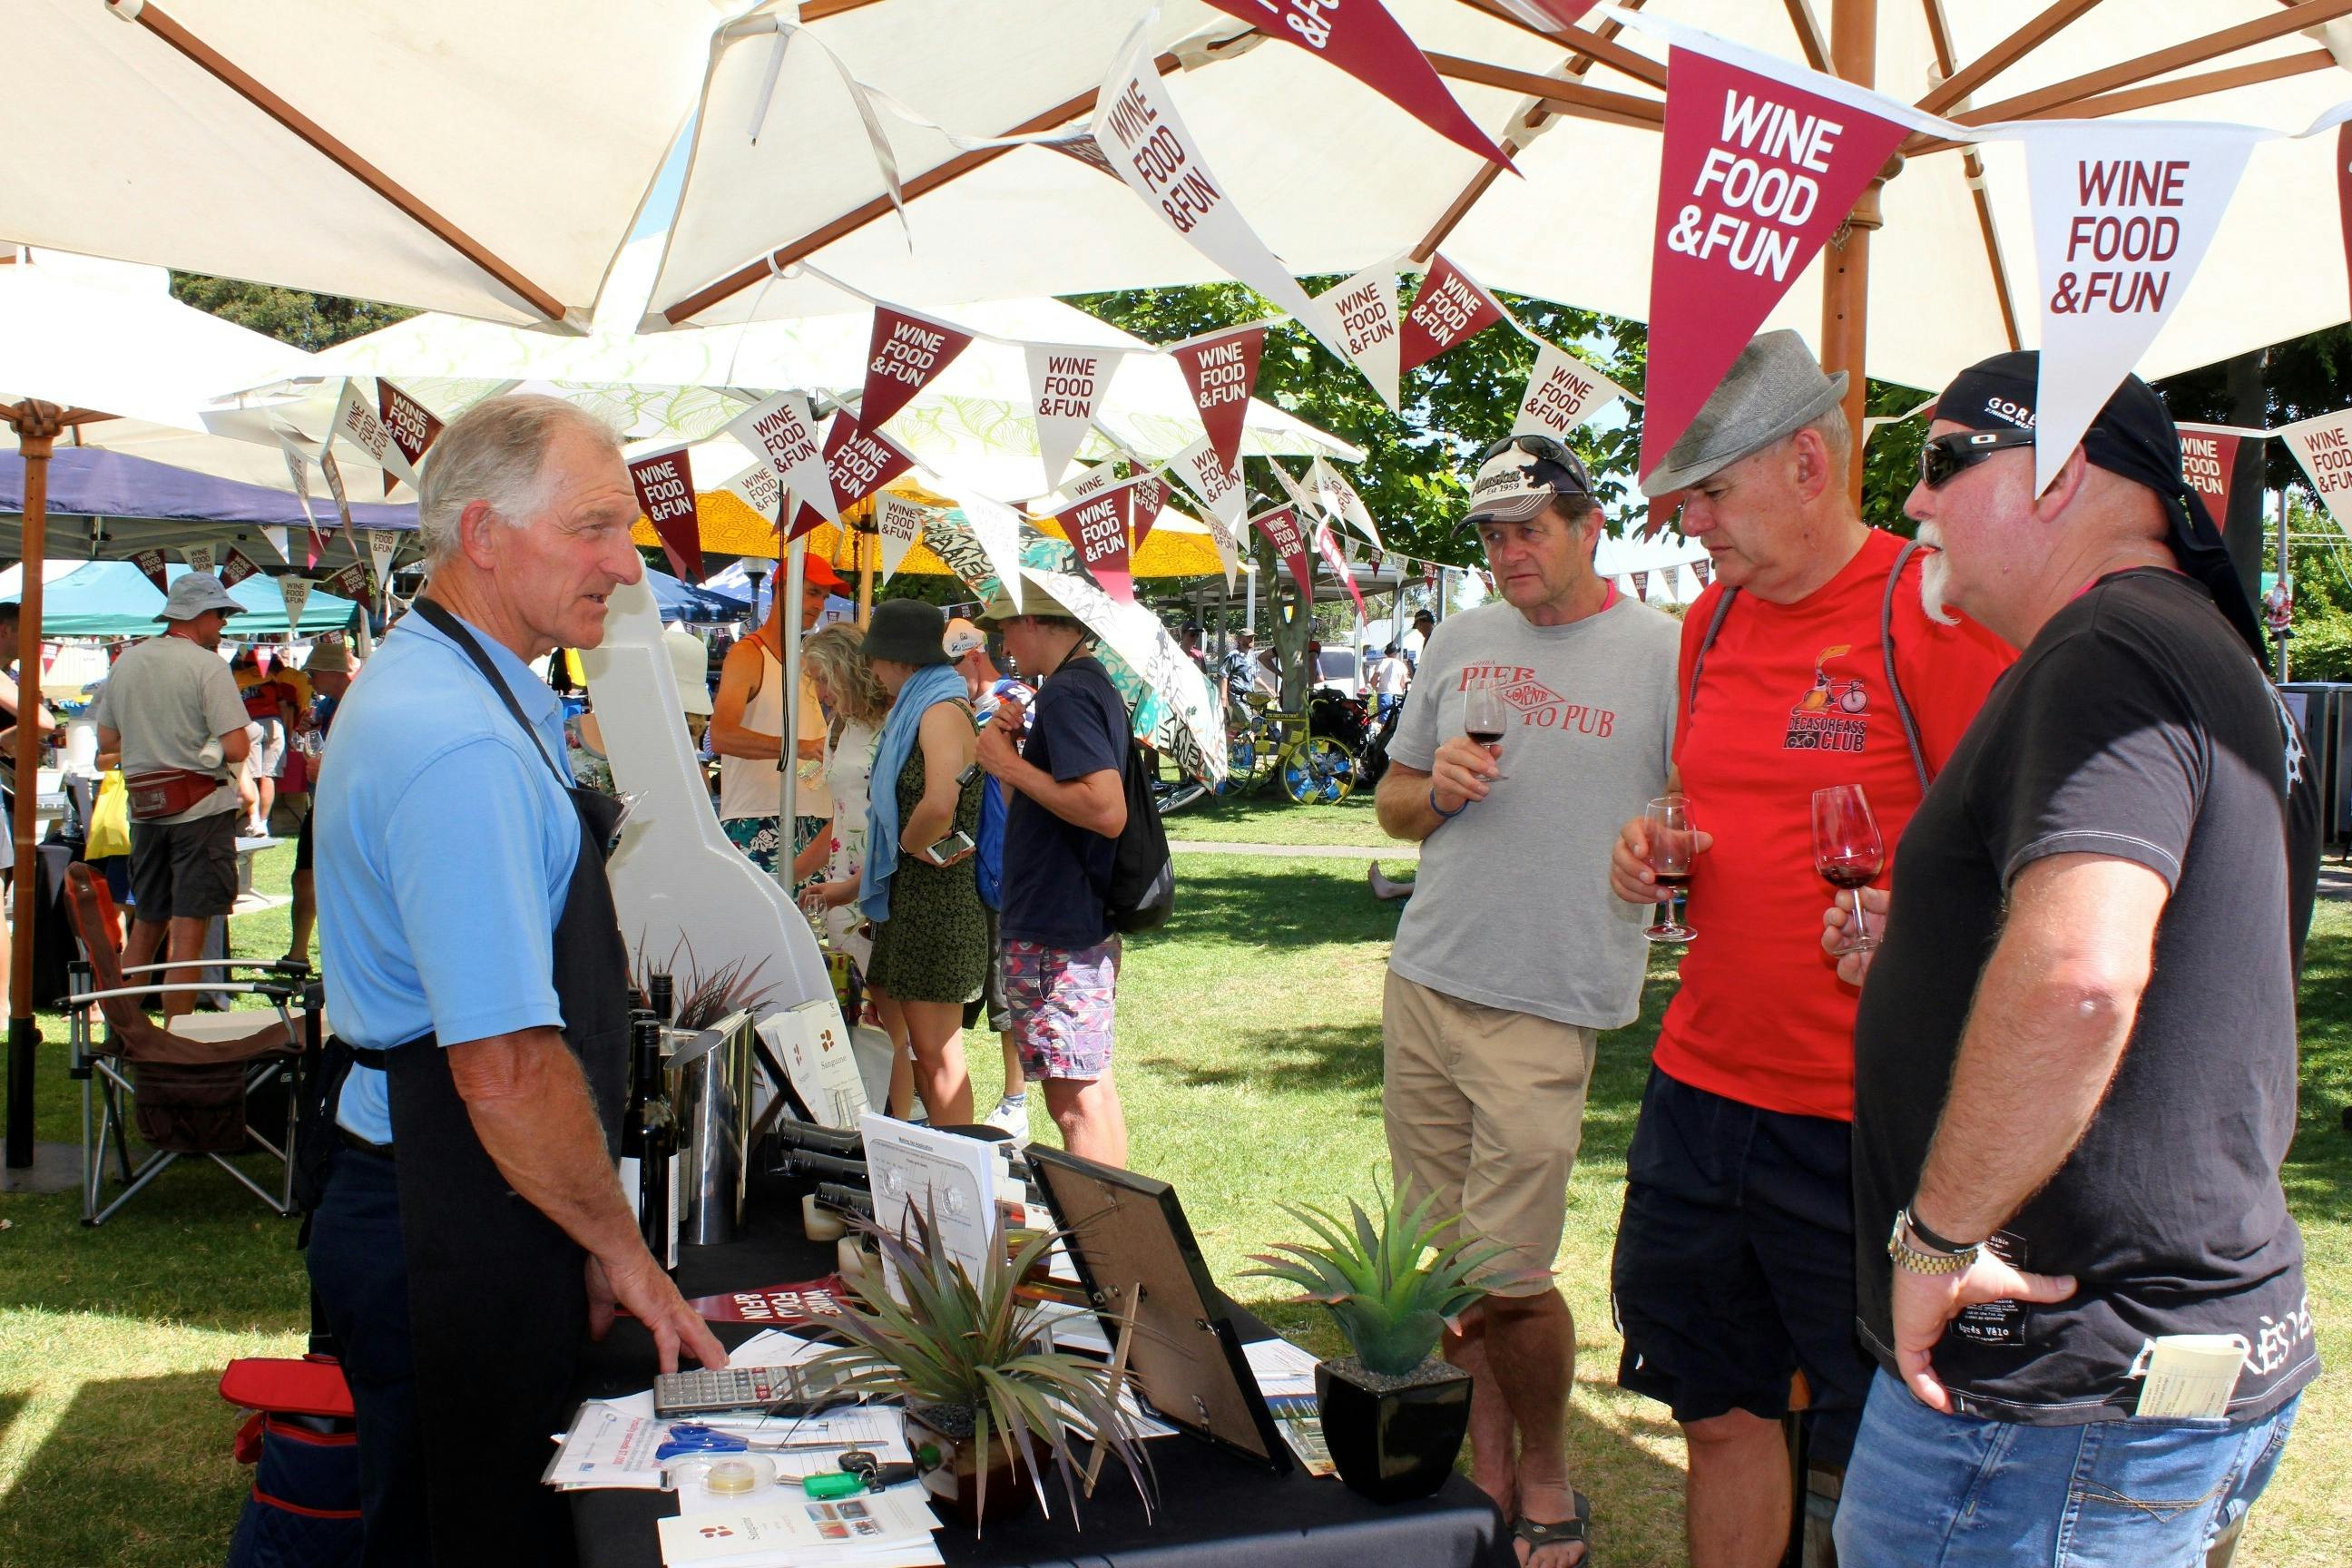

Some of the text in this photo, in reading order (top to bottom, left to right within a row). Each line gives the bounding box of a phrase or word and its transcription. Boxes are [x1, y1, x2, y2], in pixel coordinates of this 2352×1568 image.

[1286, 0, 1339, 49] &F
[1108, 79, 1157, 150] WINE
[1720, 89, 1843, 173] WINE
[1132, 124, 1187, 193] FOOD
[1693, 149, 1819, 226] FOOD
[2077, 161, 2190, 207] WINE
[1161, 167, 1220, 233] &FUN
[1668, 204, 1799, 282] &FUN
[2068, 216, 2180, 262] FOOD
[1336, 282, 1380, 317] WINE
[1441, 272, 1482, 318] WINE
[2051, 272, 2171, 314] &FUN
[1342, 302, 1387, 336] FOOD
[1426, 289, 1468, 331] FOOD
[894, 321, 945, 353] WINE
[1349, 319, 1395, 355] &FUN
[1411, 307, 1455, 348] &FUN
[881, 338, 935, 369] FOOD
[1048, 357, 1097, 376] WINE
[1197, 341, 1244, 368] WINE
[870, 357, 926, 387] &FUN
[1200, 367, 1246, 389] FOOD
[1551, 366, 1593, 404] WINE
[1044, 377, 1093, 397] FOOD
[1198, 382, 1247, 409] &FUN
[1538, 382, 1582, 416] FOOD
[346, 401, 366, 432] WINE
[393, 391, 428, 426] WINE
[752, 404, 797, 437] WINE
[1038, 398, 1091, 417] &FUN
[1524, 397, 1570, 432] &FUN
[358, 414, 377, 446] FOOD
[384, 419, 422, 454] &FUN
[389, 406, 426, 439] FOOD
[371, 426, 389, 461] &FUN
[763, 418, 806, 456] FOOD
[848, 429, 891, 468] WINE
[2180, 437, 2218, 458] WINE
[2304, 427, 2348, 452] WINE
[773, 439, 818, 474] &FUN
[833, 444, 878, 483] FOOD
[1191, 447, 1220, 470] WIN
[2181, 456, 2220, 476] FOOD
[2311, 449, 2352, 473] FOOD
[636, 460, 678, 484] WINE
[741, 467, 771, 489] WINE
[825, 460, 867, 499] &FUN
[1075, 475, 1105, 495] WINE
[1200, 461, 1224, 487] FOO
[1471, 470, 1521, 497] Alaska
[2181, 474, 2224, 495] &FUN
[645, 478, 686, 504] FOOD
[750, 479, 778, 500] FOOD
[755, 487, 787, 512] &FUN
[1137, 482, 1159, 504] FOOD
[1206, 470, 1241, 503] &FUN
[1500, 483, 1520, 492] 1959
[651, 497, 693, 522] &FUN
[887, 502, 916, 519] WINE
[1076, 498, 1116, 527] WINE
[1134, 492, 1158, 516] &FUN
[881, 524, 912, 542] &FUN
[886, 513, 915, 530] FOOD
[1081, 516, 1121, 544] FOOD
[1265, 516, 1289, 534] WINE
[372, 544, 392, 554] &FUN
[374, 534, 394, 544] FOOD
[1085, 534, 1125, 563] &FUN
[1273, 528, 1296, 545] FOOD
[1279, 540, 1303, 558] &FUN
[1456, 666, 1535, 691] PIER
[1504, 685, 1549, 706] LORNE
[1521, 705, 1616, 738] TO PUB
[1820, 731, 1865, 752] CLUB
[820, 1056, 848, 1070] Sanguine
[733, 1293, 774, 1319] &FUN
[802, 1289, 843, 1314] WINE
